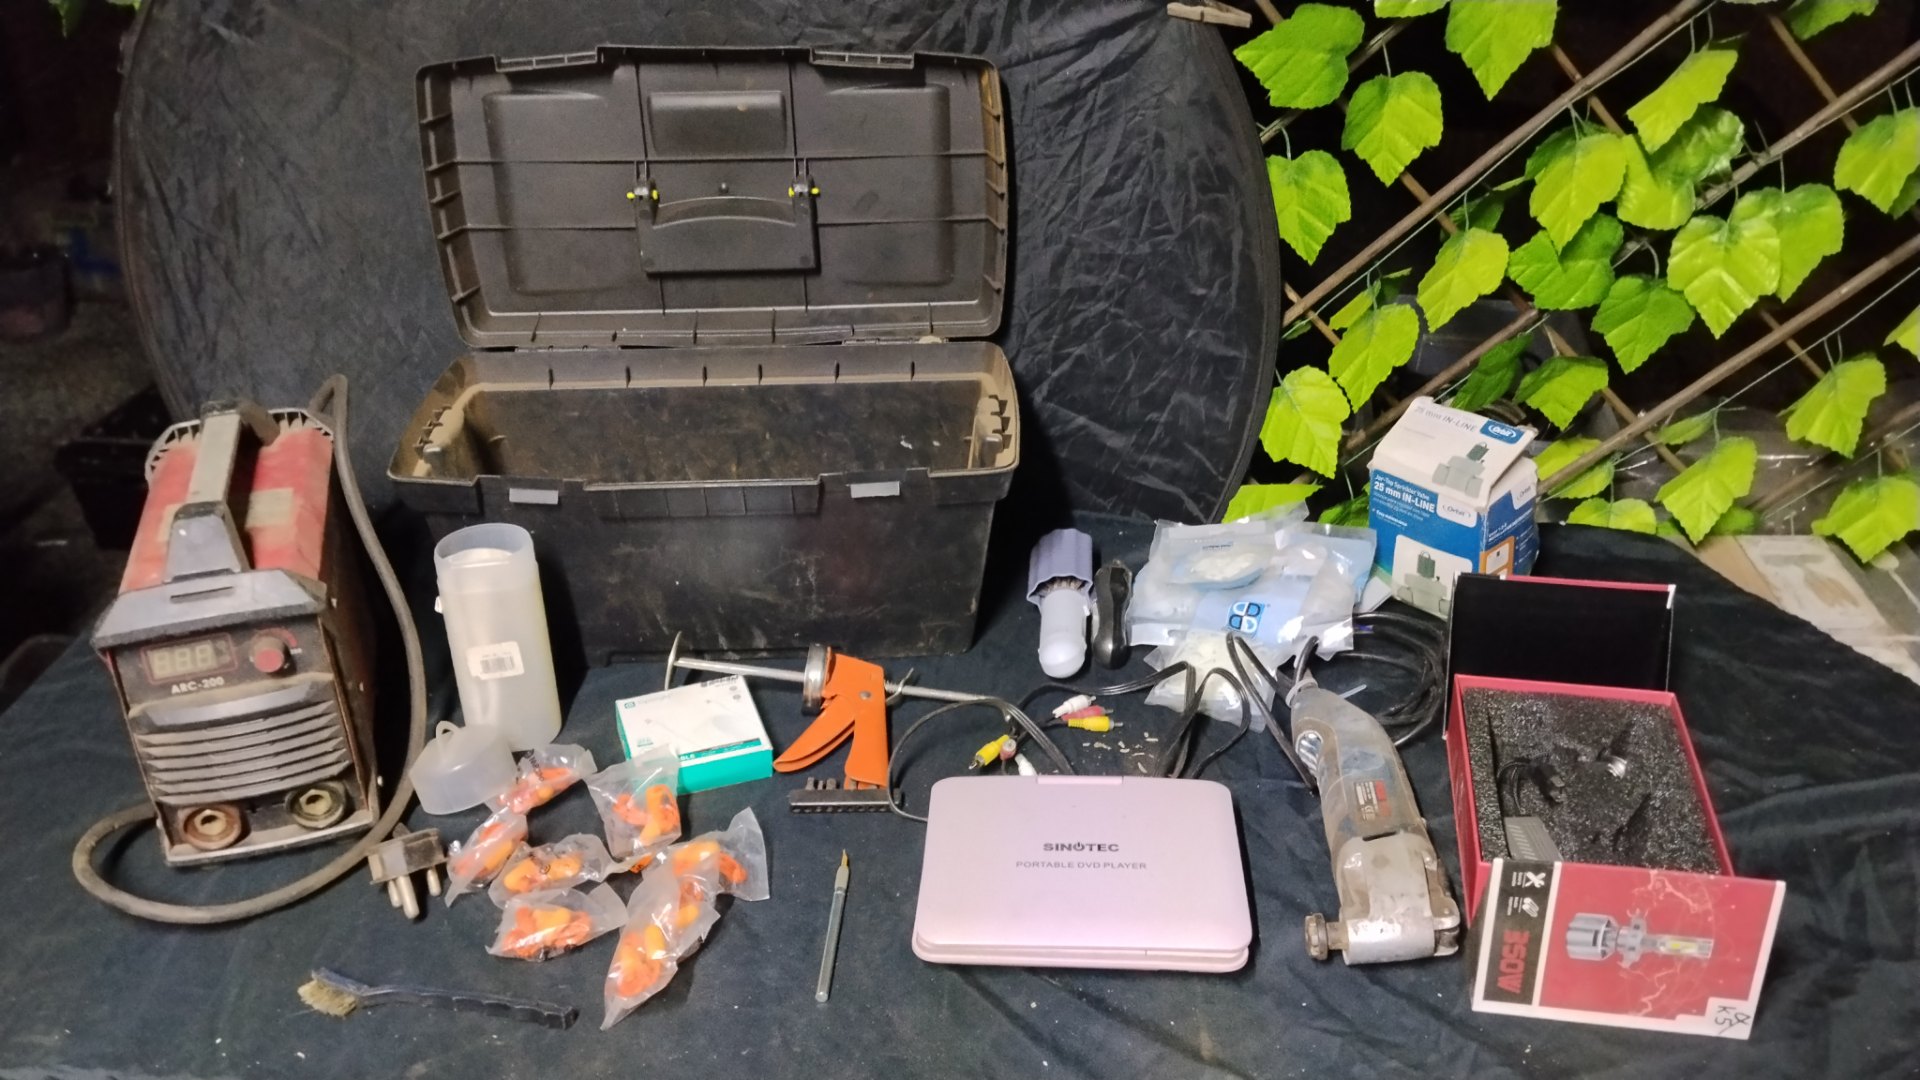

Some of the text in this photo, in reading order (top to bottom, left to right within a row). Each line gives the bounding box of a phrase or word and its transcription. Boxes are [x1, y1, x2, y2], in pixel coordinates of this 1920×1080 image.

[1443, 414, 1477, 432] IN-LINE
[1374, 480, 1384, 491] 25
[1385, 486, 1401, 499] mm
[1402, 491, 1435, 513] IN-LINE
[171, 676, 225, 694] ARC-200
[1043, 841, 1119, 852] SINOTEC
[1016, 861, 1074, 869] PORTABLE
[1103, 862, 1147, 870] PLAYER
